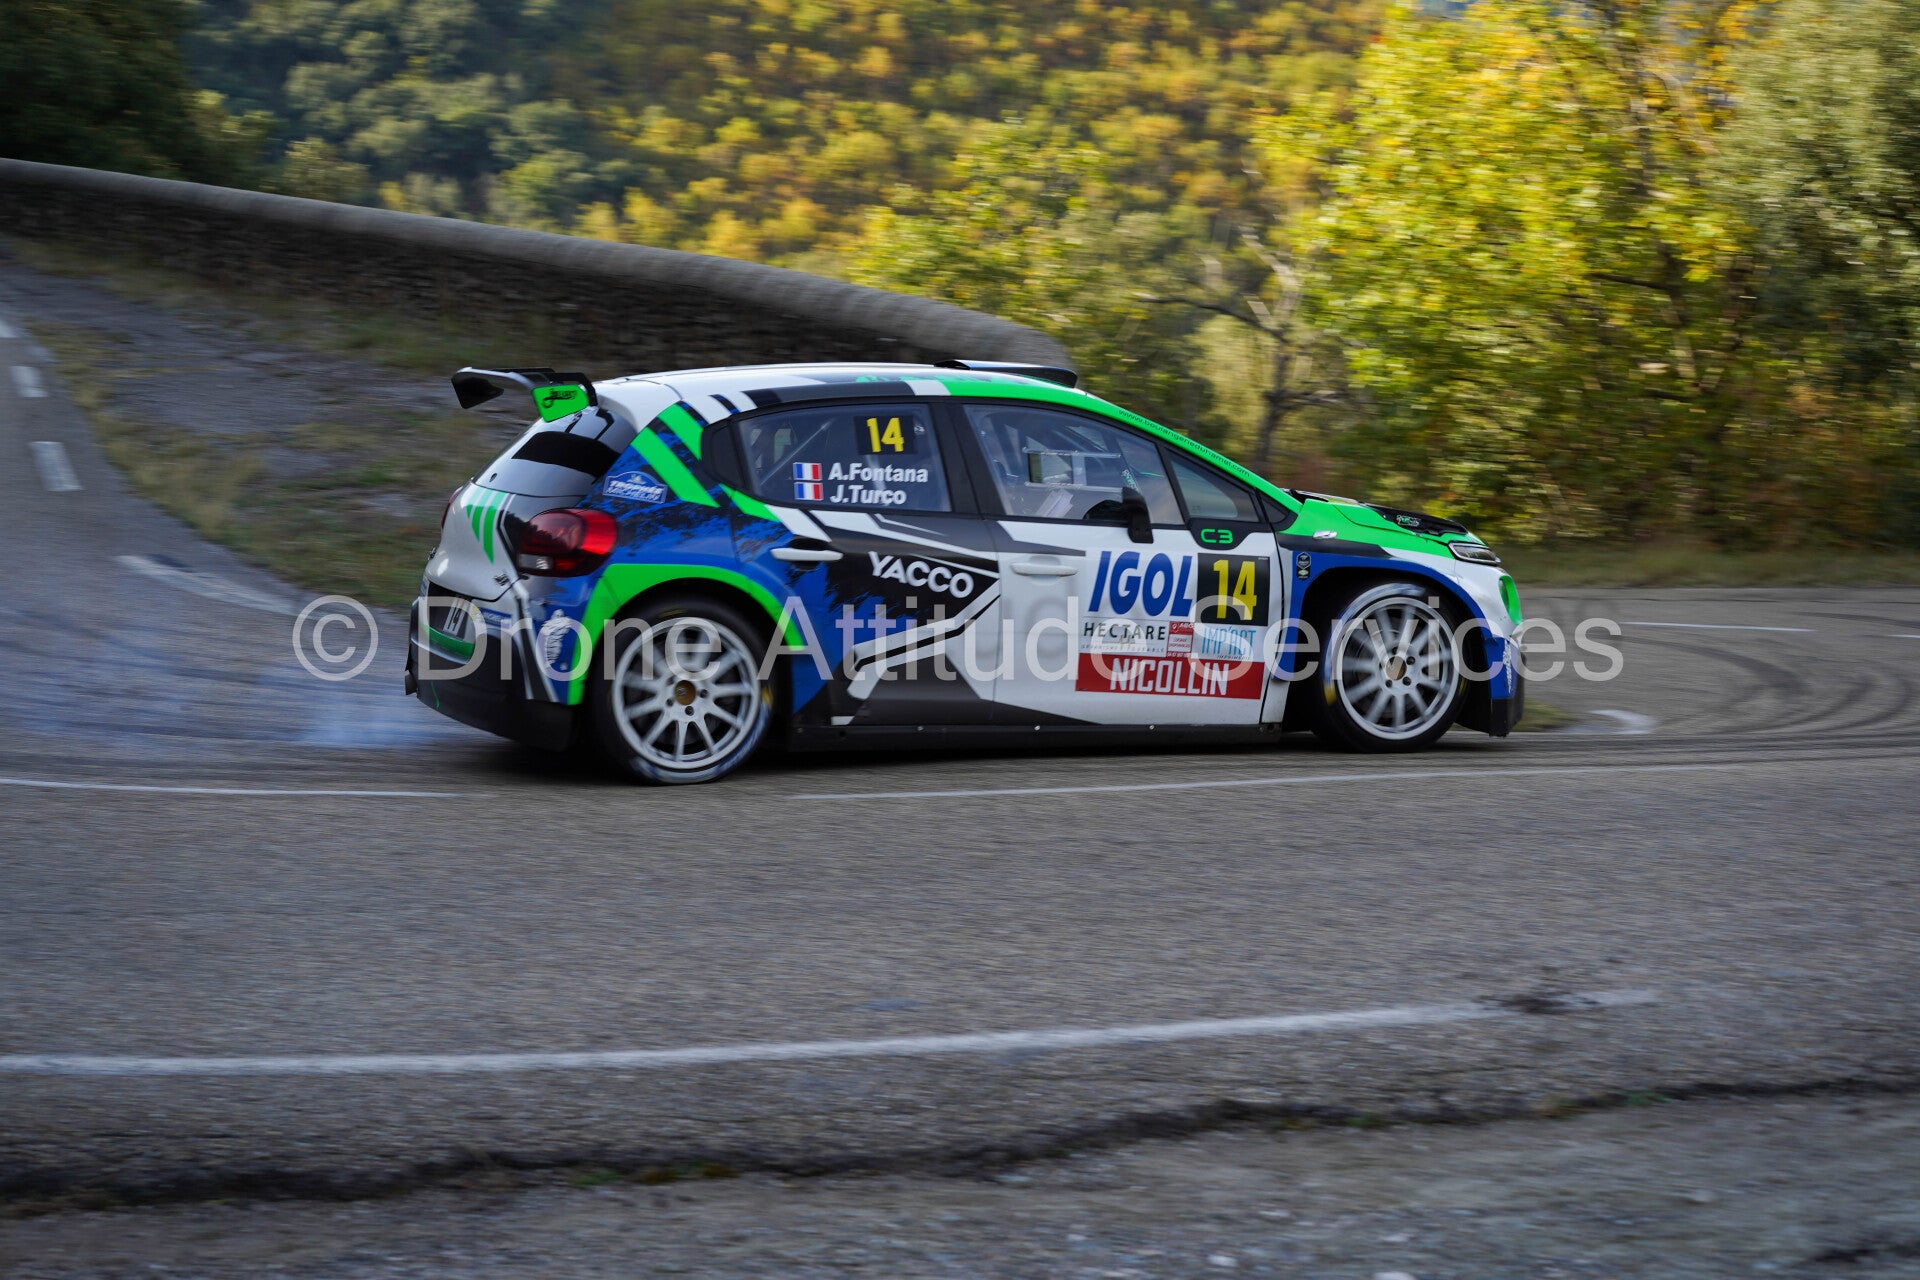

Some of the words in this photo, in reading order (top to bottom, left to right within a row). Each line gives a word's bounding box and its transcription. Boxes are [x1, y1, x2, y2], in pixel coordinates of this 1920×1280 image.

[866, 416, 906, 454] 14
[828, 462, 929, 484] A.Fontana
[1200, 528, 1234, 545] C3
[867, 551, 975, 599] YACCO
[1088, 551, 1193, 617] IGOL
[1213, 559, 1258, 621] 14
[1083, 621, 1166, 641] HECTARE
[1109, 657, 1230, 696] NICOLLIN
